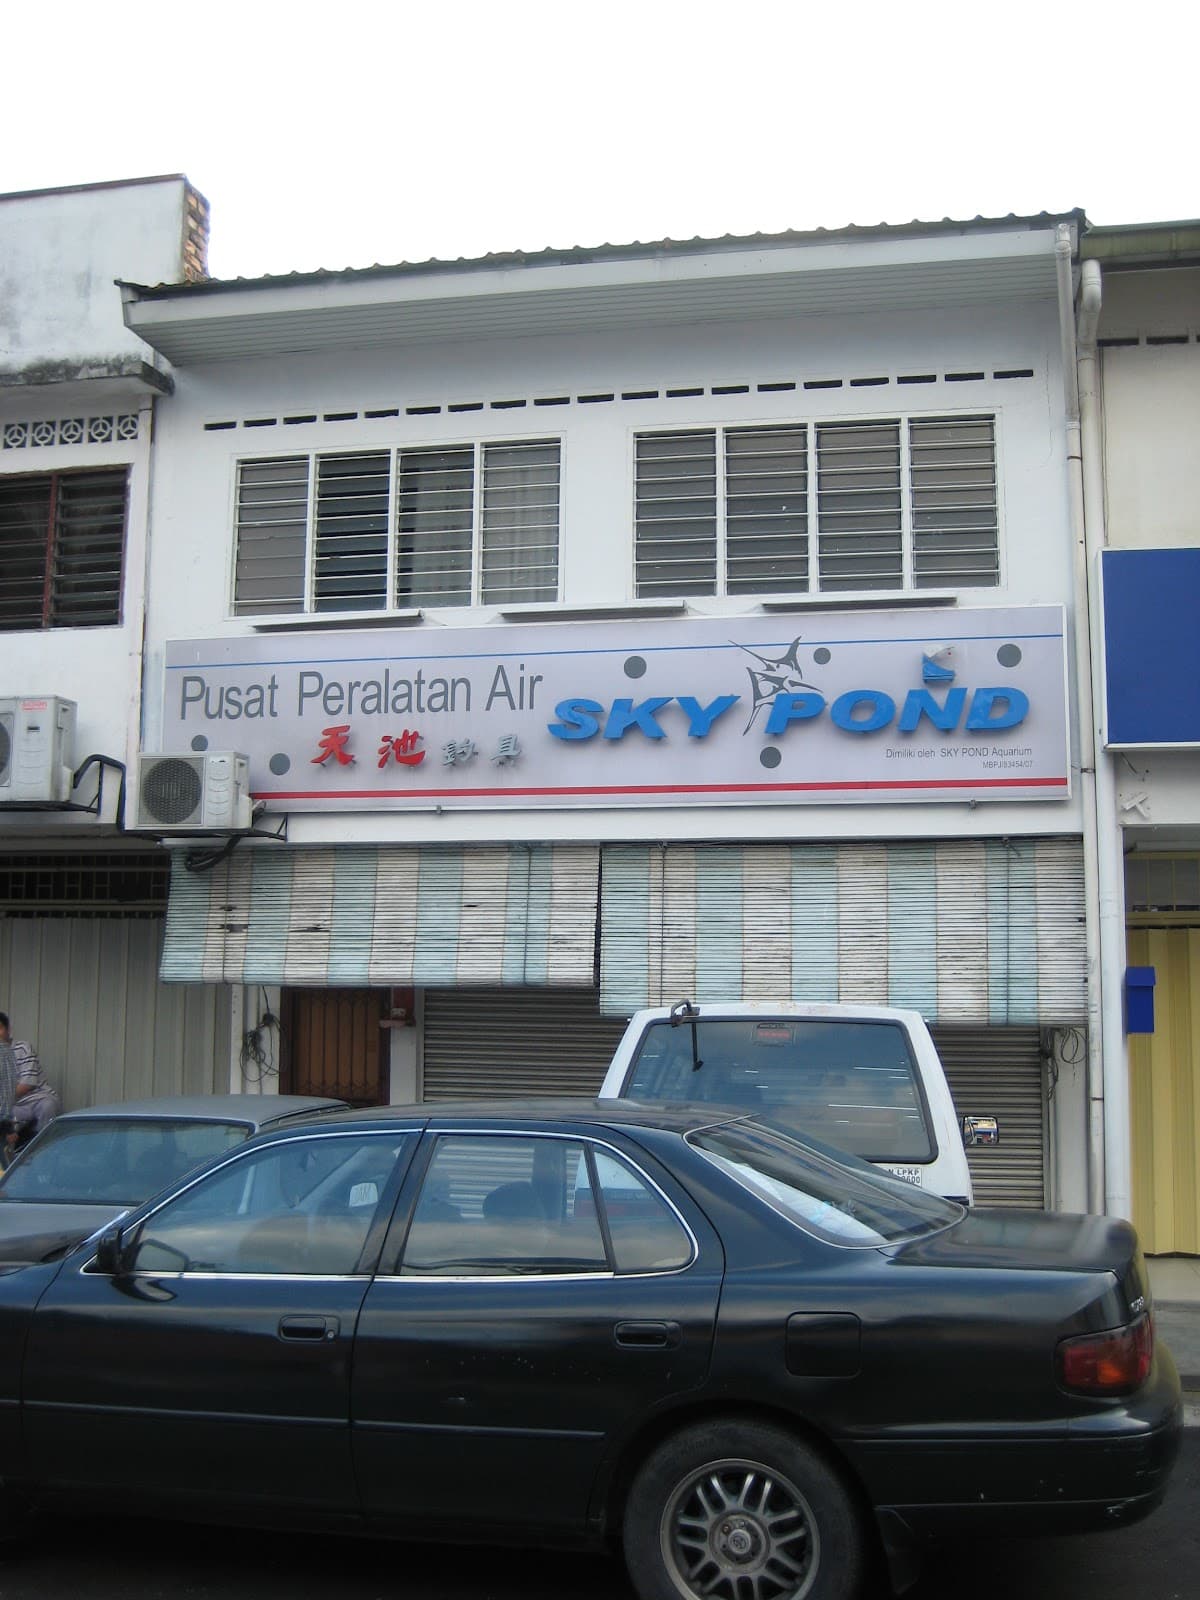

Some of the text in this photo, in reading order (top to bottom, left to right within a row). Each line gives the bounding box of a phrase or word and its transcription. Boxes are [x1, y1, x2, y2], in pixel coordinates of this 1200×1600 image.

[180, 663, 544, 721] Pusat Peralatan Air
[547, 687, 1030, 740] SKY POND
[917, 749, 936, 758] oleh
[940, 748, 959, 758] SKY
[961, 747, 989, 758] POND
[991, 746, 1032, 758] Aquarium
